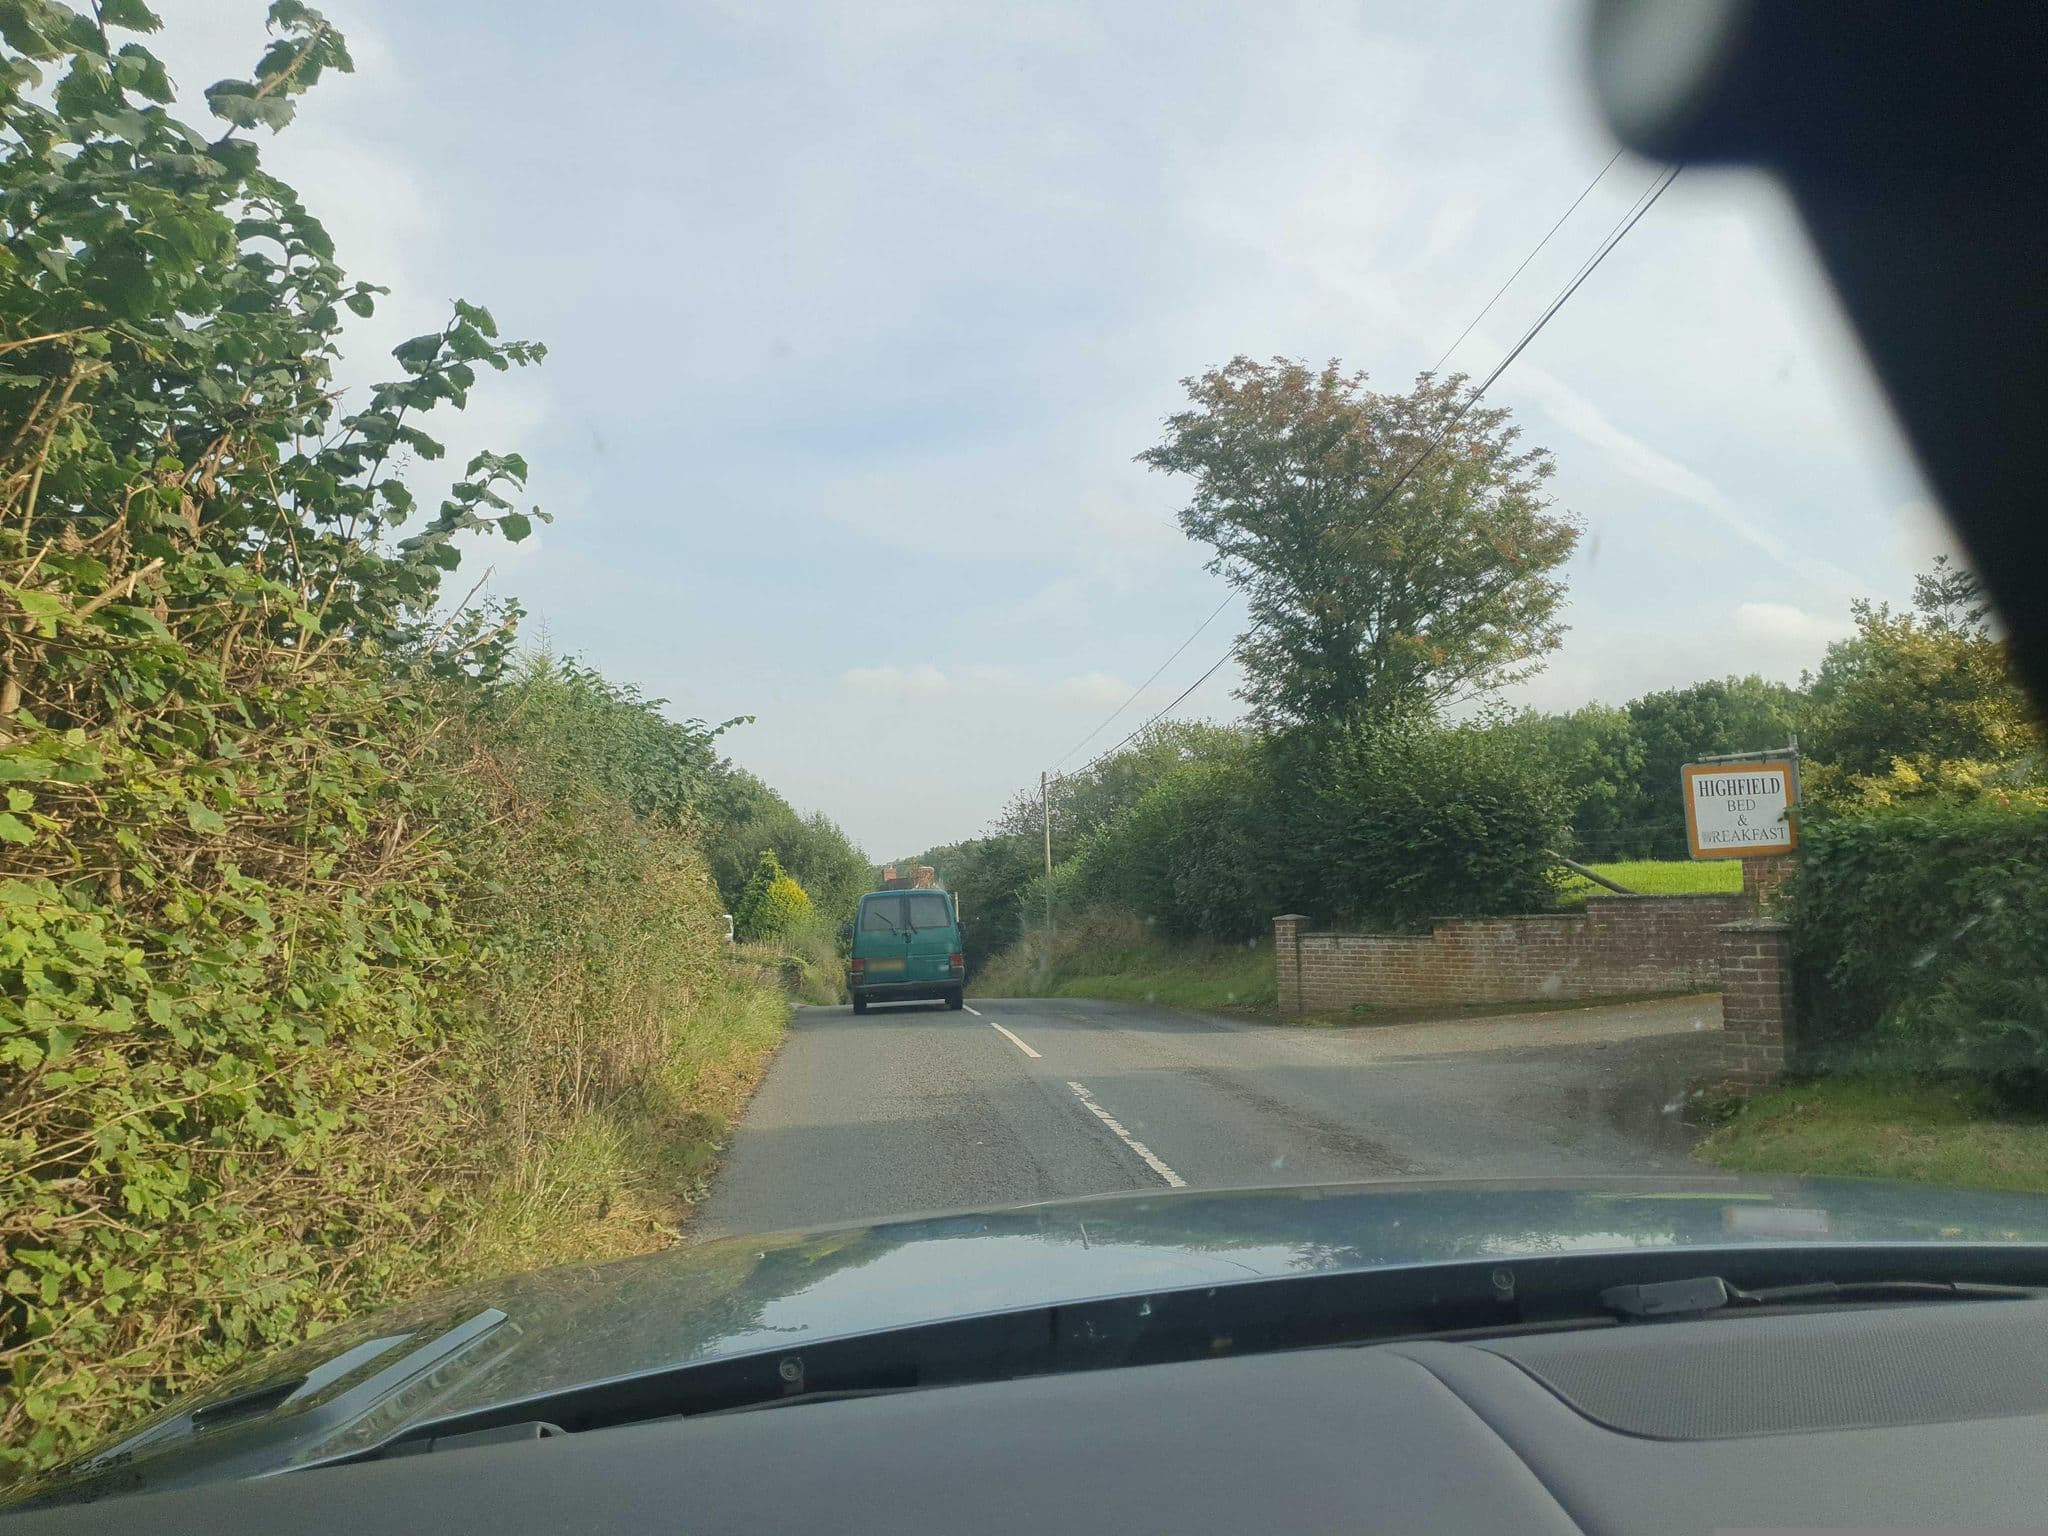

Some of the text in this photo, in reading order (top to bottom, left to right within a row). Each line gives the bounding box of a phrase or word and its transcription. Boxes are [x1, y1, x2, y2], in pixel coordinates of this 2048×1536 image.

[1698, 777, 1780, 797] HIGHFIELD
[1727, 799, 1756, 812] BED
[1737, 815, 1748, 826] &
